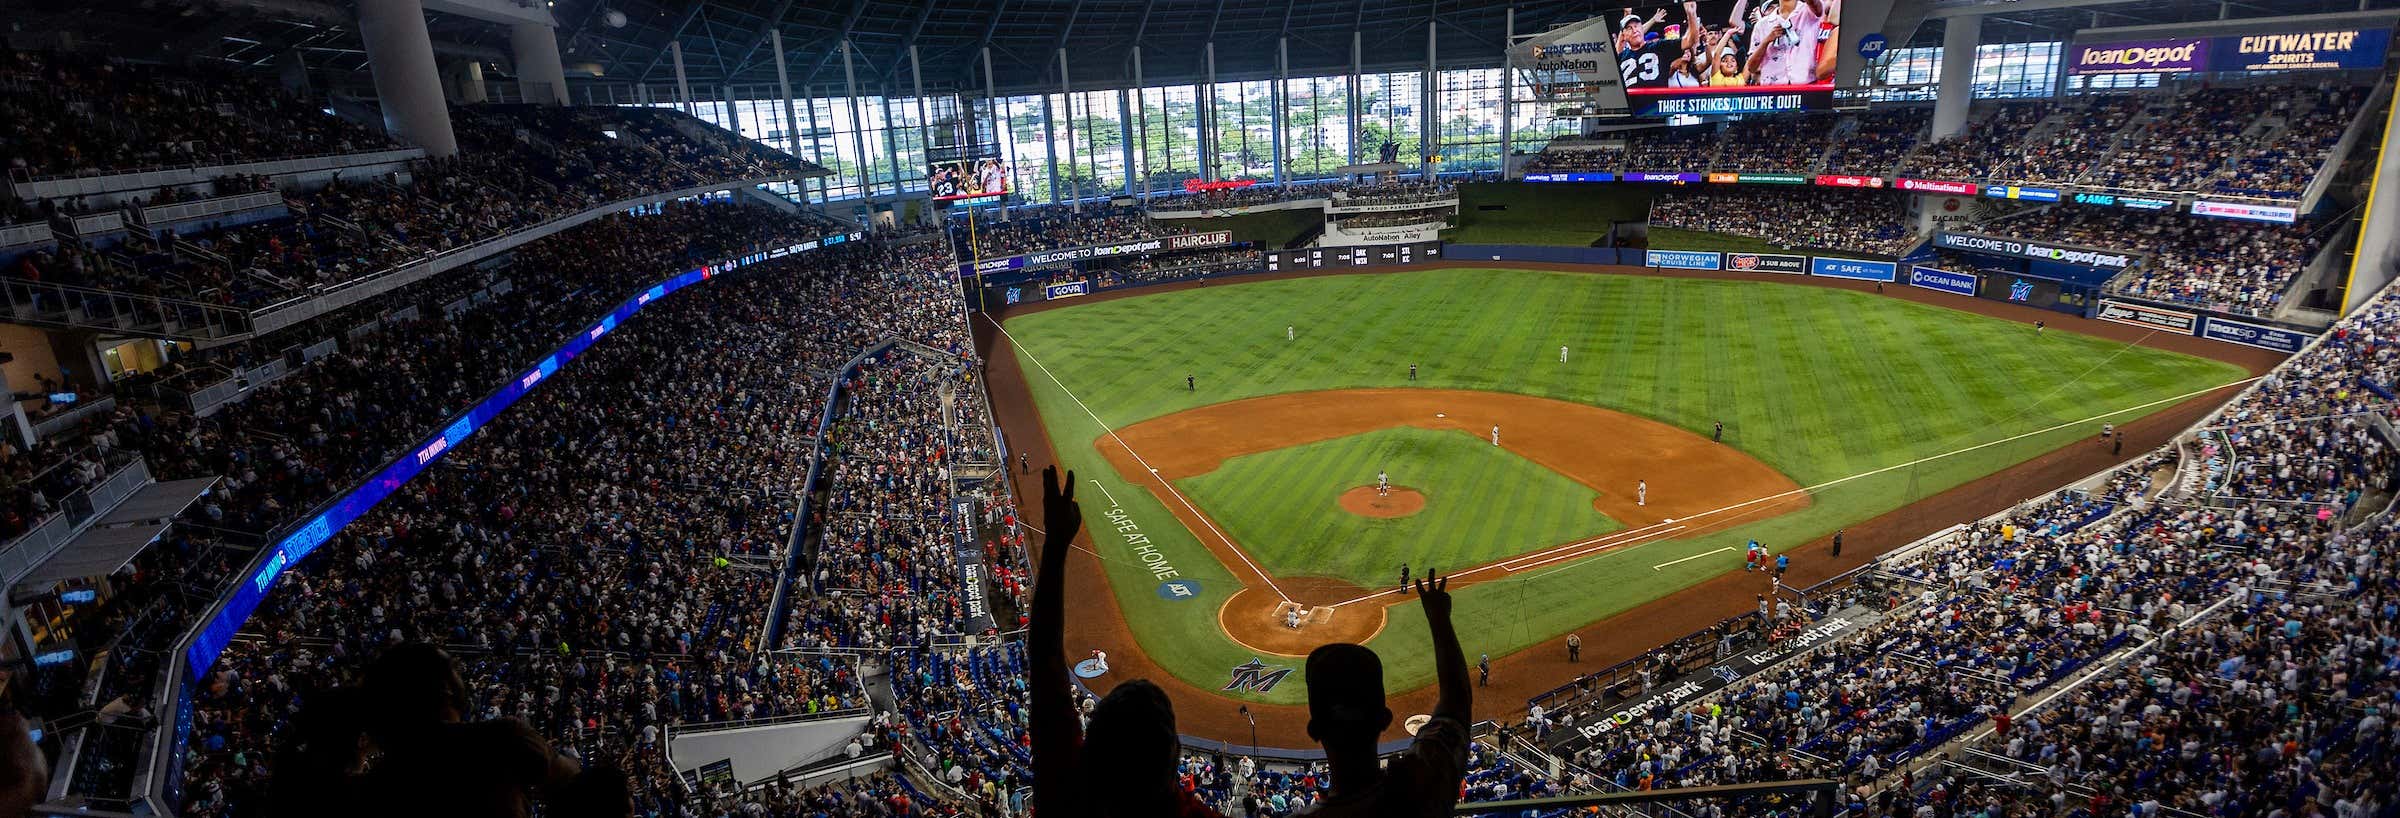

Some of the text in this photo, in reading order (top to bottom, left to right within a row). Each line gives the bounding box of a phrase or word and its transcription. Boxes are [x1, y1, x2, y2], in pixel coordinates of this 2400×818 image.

[1861, 41, 1884, 51] ADT
[2239, 31, 2354, 53] CUTWATER
[2080, 43, 2196, 66] loanDepot
[2268, 53, 2314, 63] SPIRITS
[1536, 59, 1597, 72] AutoNation
[1620, 52, 1660, 88] 23
[1658, 99, 1685, 113] THREE
[1738, 96, 1774, 110] YOU'RE
[1777, 94, 1802, 109] OUT!
[937, 182, 953, 197] 23
[1914, 181, 1966, 192] Multinational
[2086, 195, 2114, 205] AMG
[1172, 233, 1227, 248] HAIRCLUB
[1363, 233, 1400, 242] AutoNation
[1404, 231, 1421, 240] Alley
[1031, 240, 1161, 264] WELCOME TO loanDepot park
[1662, 254, 1718, 262] NORWEGIAN
[1945, 234, 2130, 268] WELCOME TO loanDepot park
[1841, 265, 1862, 273] SAFE
[1055, 284, 1081, 295] GOYA
[1924, 275, 1973, 289] OCEAN BANK
[2209, 323, 2257, 340] maxsip
[285, 516, 330, 563] STRETCH
[1104, 508, 1179, 580] SAFE AT HOME
[1167, 583, 1193, 597] ADT
[1817, 616, 1852, 637] park
